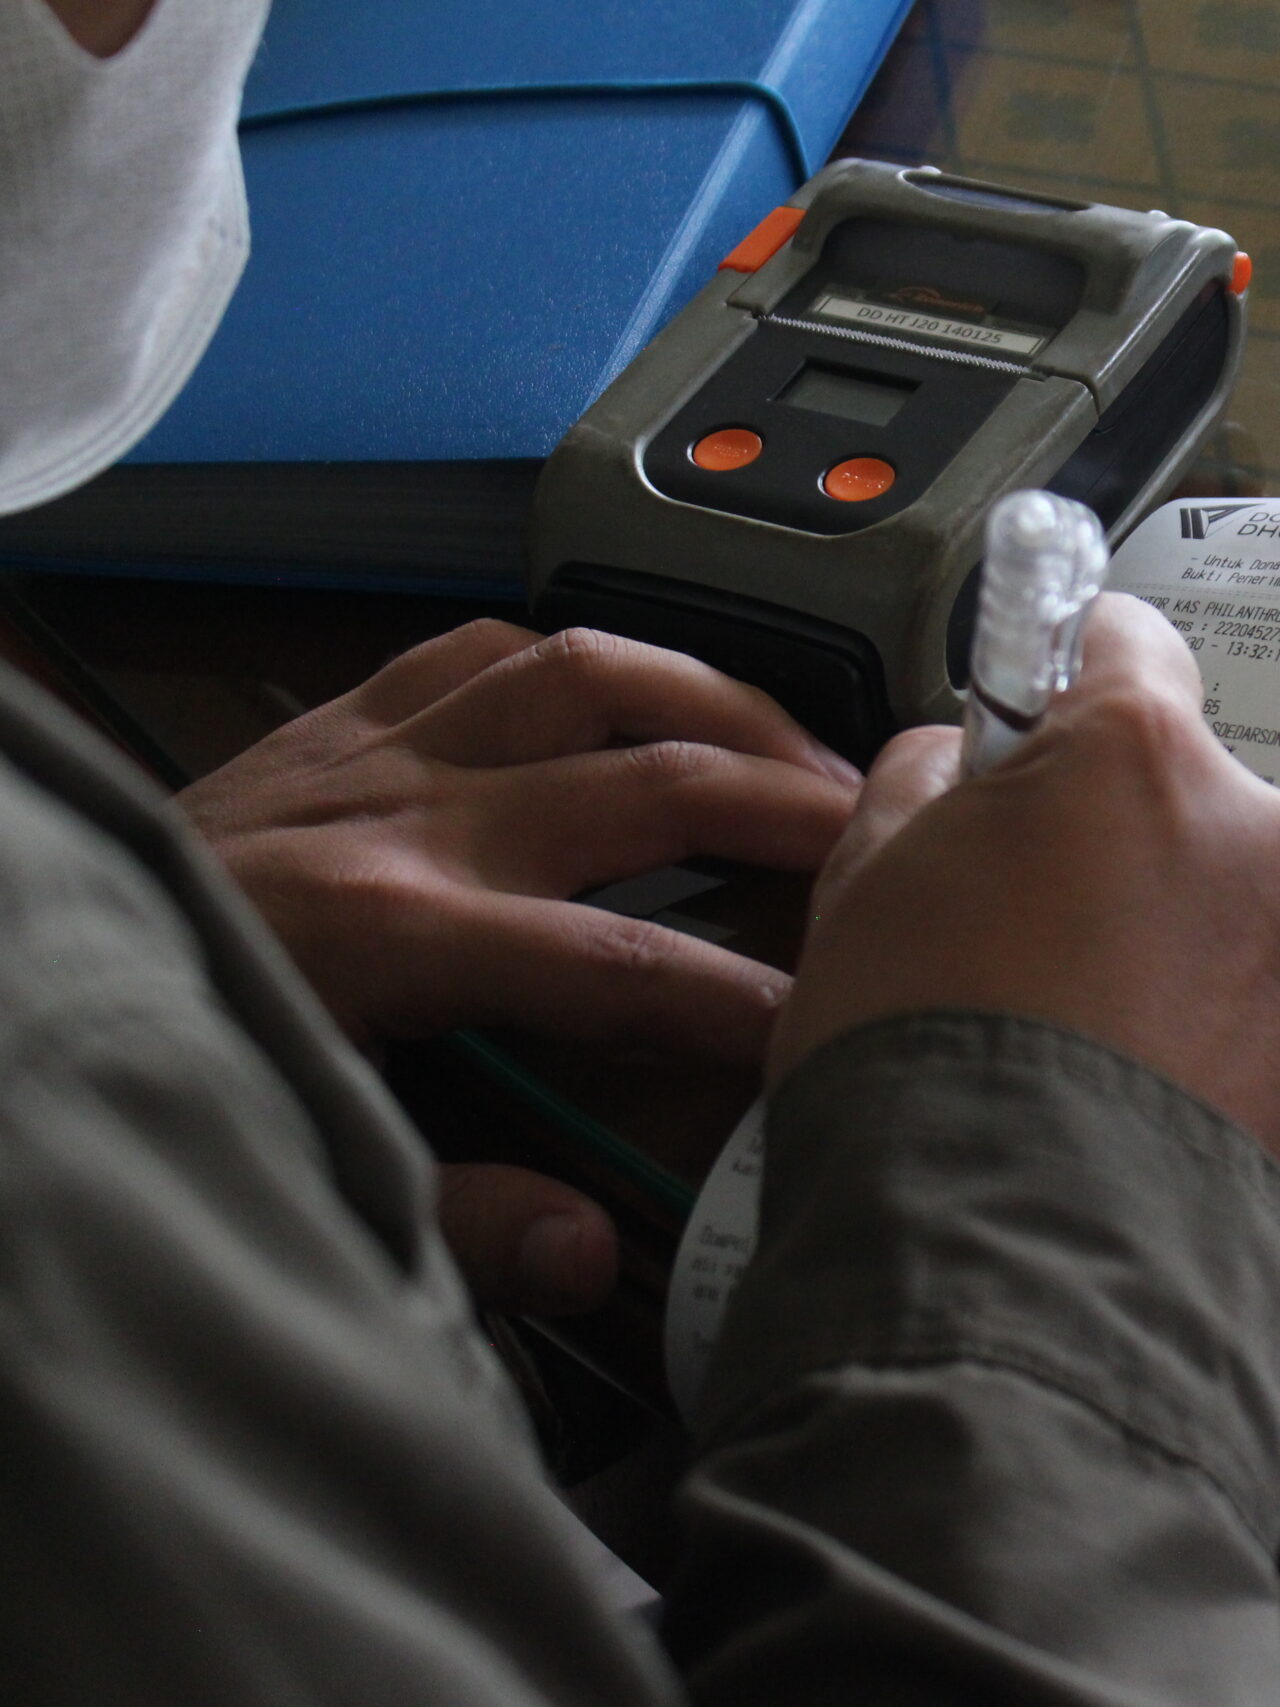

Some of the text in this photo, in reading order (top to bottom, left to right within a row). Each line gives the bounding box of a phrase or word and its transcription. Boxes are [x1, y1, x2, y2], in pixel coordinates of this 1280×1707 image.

[856, 307, 883, 319] DD
[885, 312, 911, 324] HT
[942, 323, 1003, 343] 140125
[1204, 555, 1246, 570] Untuk
[1181, 567, 1223, 584] Bukti
[1173, 599, 1201, 614] KAS
